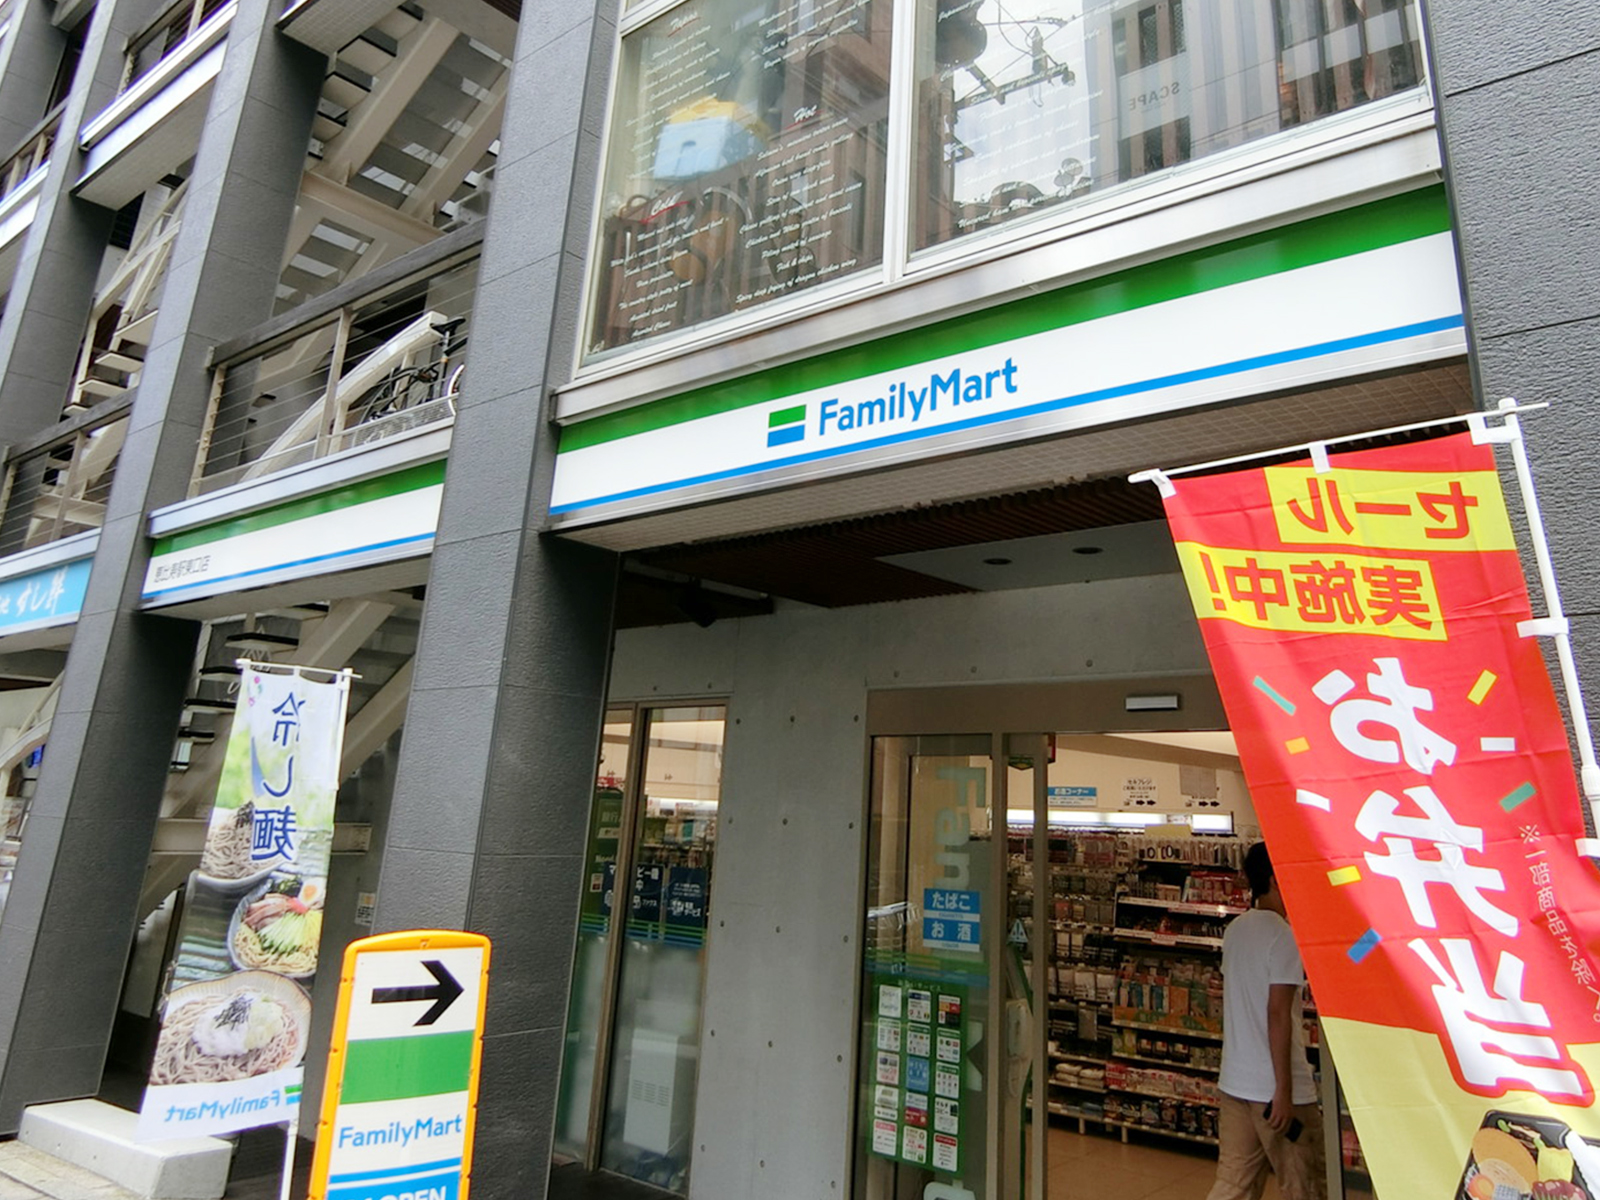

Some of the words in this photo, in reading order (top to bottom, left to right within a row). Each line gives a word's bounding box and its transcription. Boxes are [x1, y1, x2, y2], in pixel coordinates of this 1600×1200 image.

[794, 104, 818, 123] Hot
[651, 191, 682, 216] Cold
[819, 357, 1018, 437] FamilyMart
[931, 890, 971, 910] たばこ
[930, 919, 972, 941] お酒
[338, 1114, 463, 1149] FamilyMart
